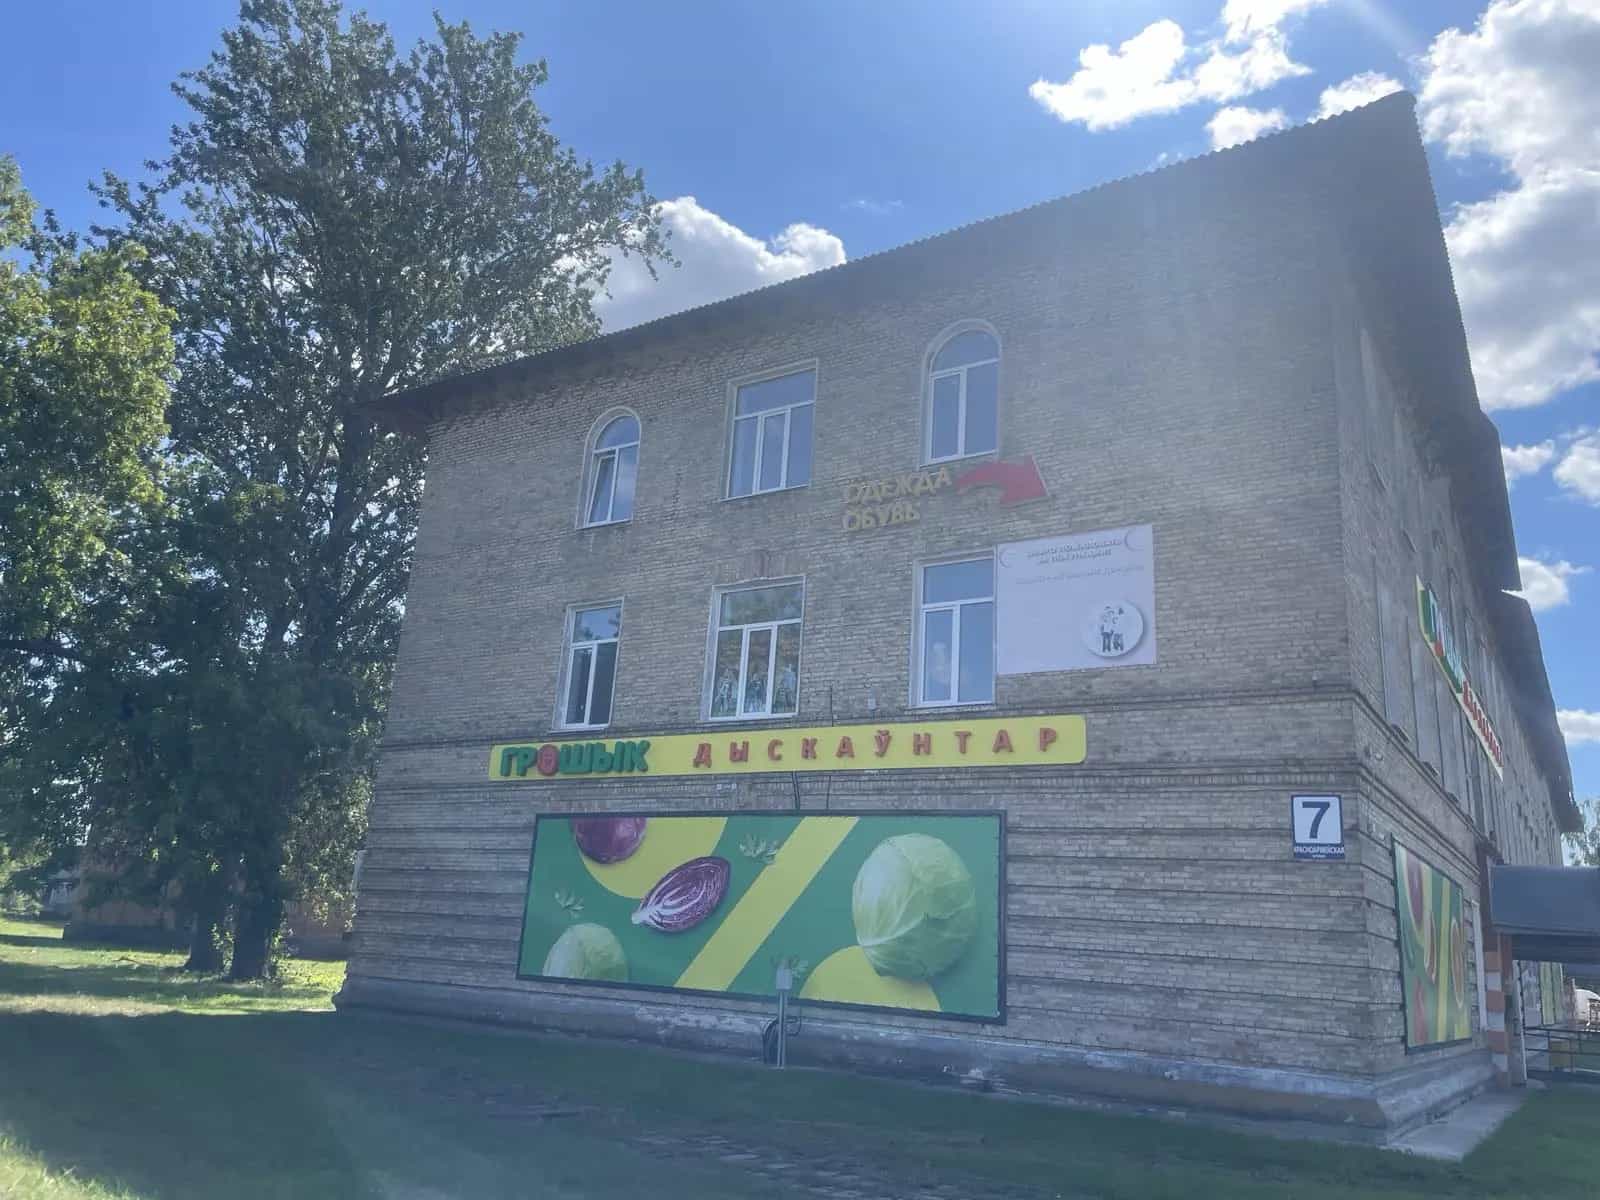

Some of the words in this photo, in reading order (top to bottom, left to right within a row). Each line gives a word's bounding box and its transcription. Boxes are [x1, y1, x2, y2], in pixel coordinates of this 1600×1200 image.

[841, 502, 920, 530] ОБУВЬ
[500, 740, 650, 776] ГРОШЫК
[693, 728, 1057, 767] ДЫСКАЎНТАР
[1302, 801, 1330, 838] 7
